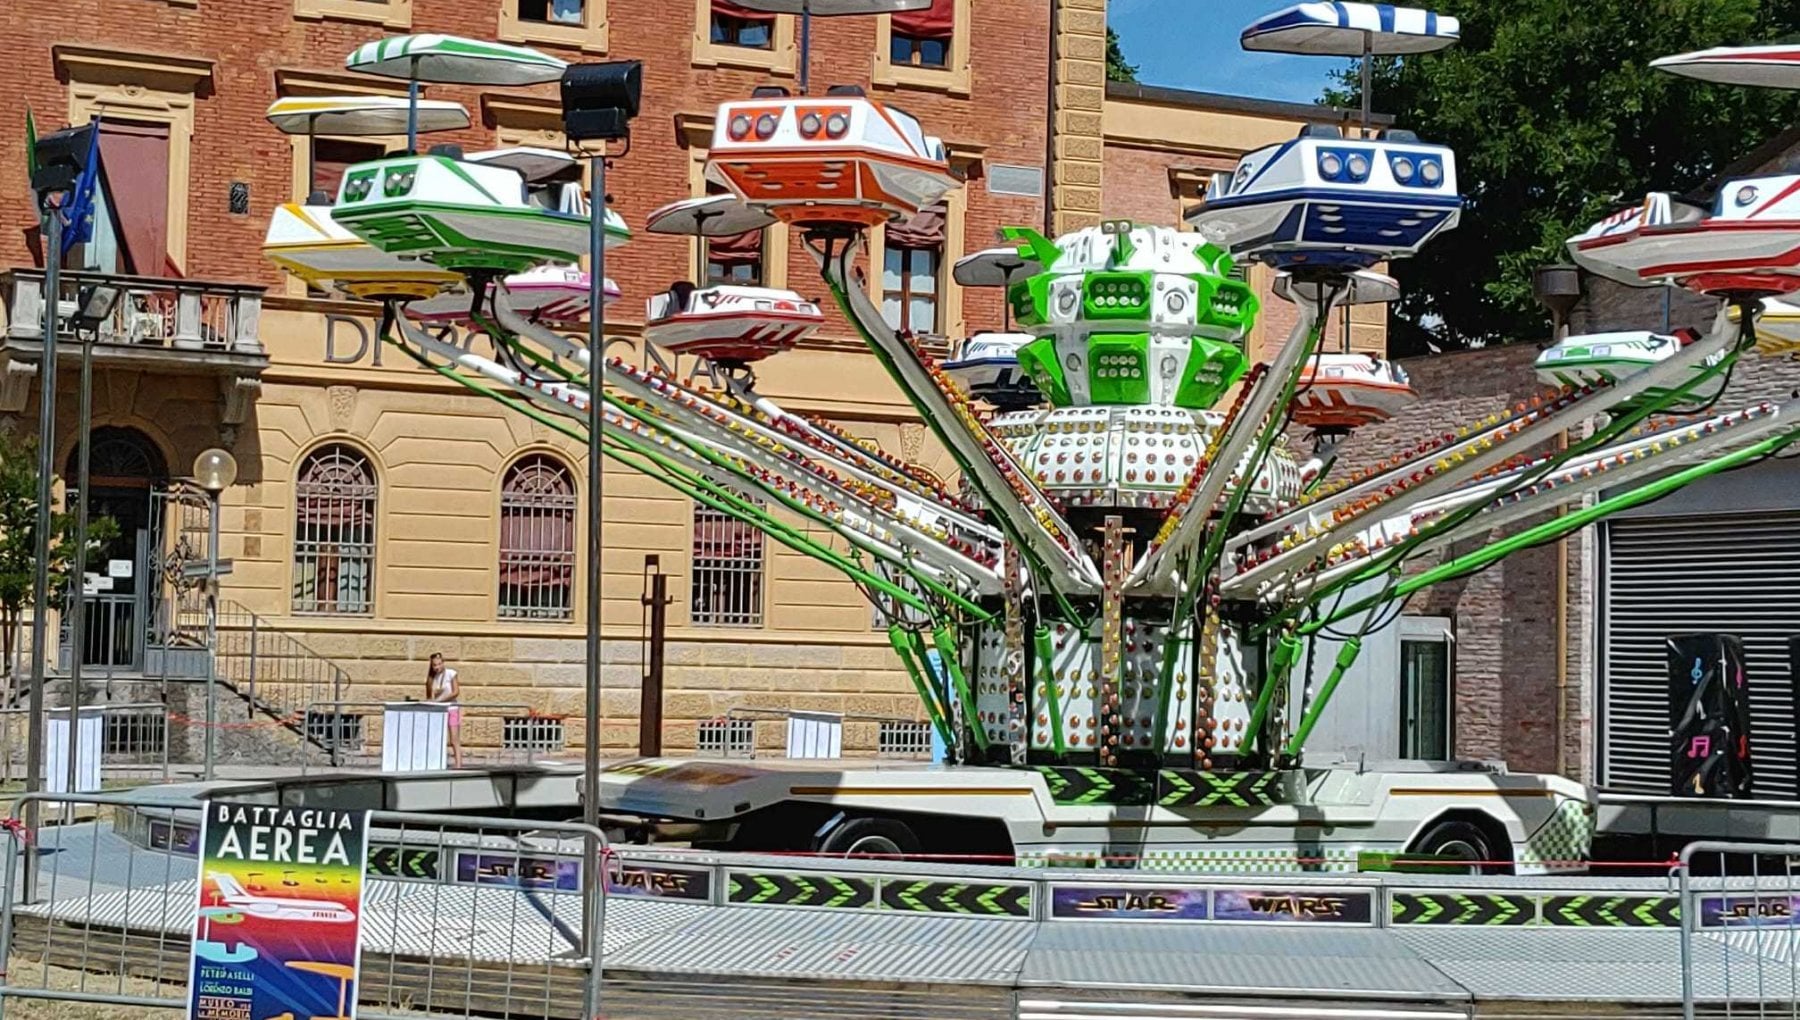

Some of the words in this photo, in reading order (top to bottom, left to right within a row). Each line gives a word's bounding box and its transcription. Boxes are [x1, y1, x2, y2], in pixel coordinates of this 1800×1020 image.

[324, 314, 386, 367] DI
[418, 321, 724, 390] BOGNA
[218, 804, 352, 830] BATTAGLIA
[216, 825, 350, 866] AEREA
[1075, 892, 1184, 914] STAR
[1247, 894, 1348, 918] WARS
[1713, 900, 1796, 921] STAR
